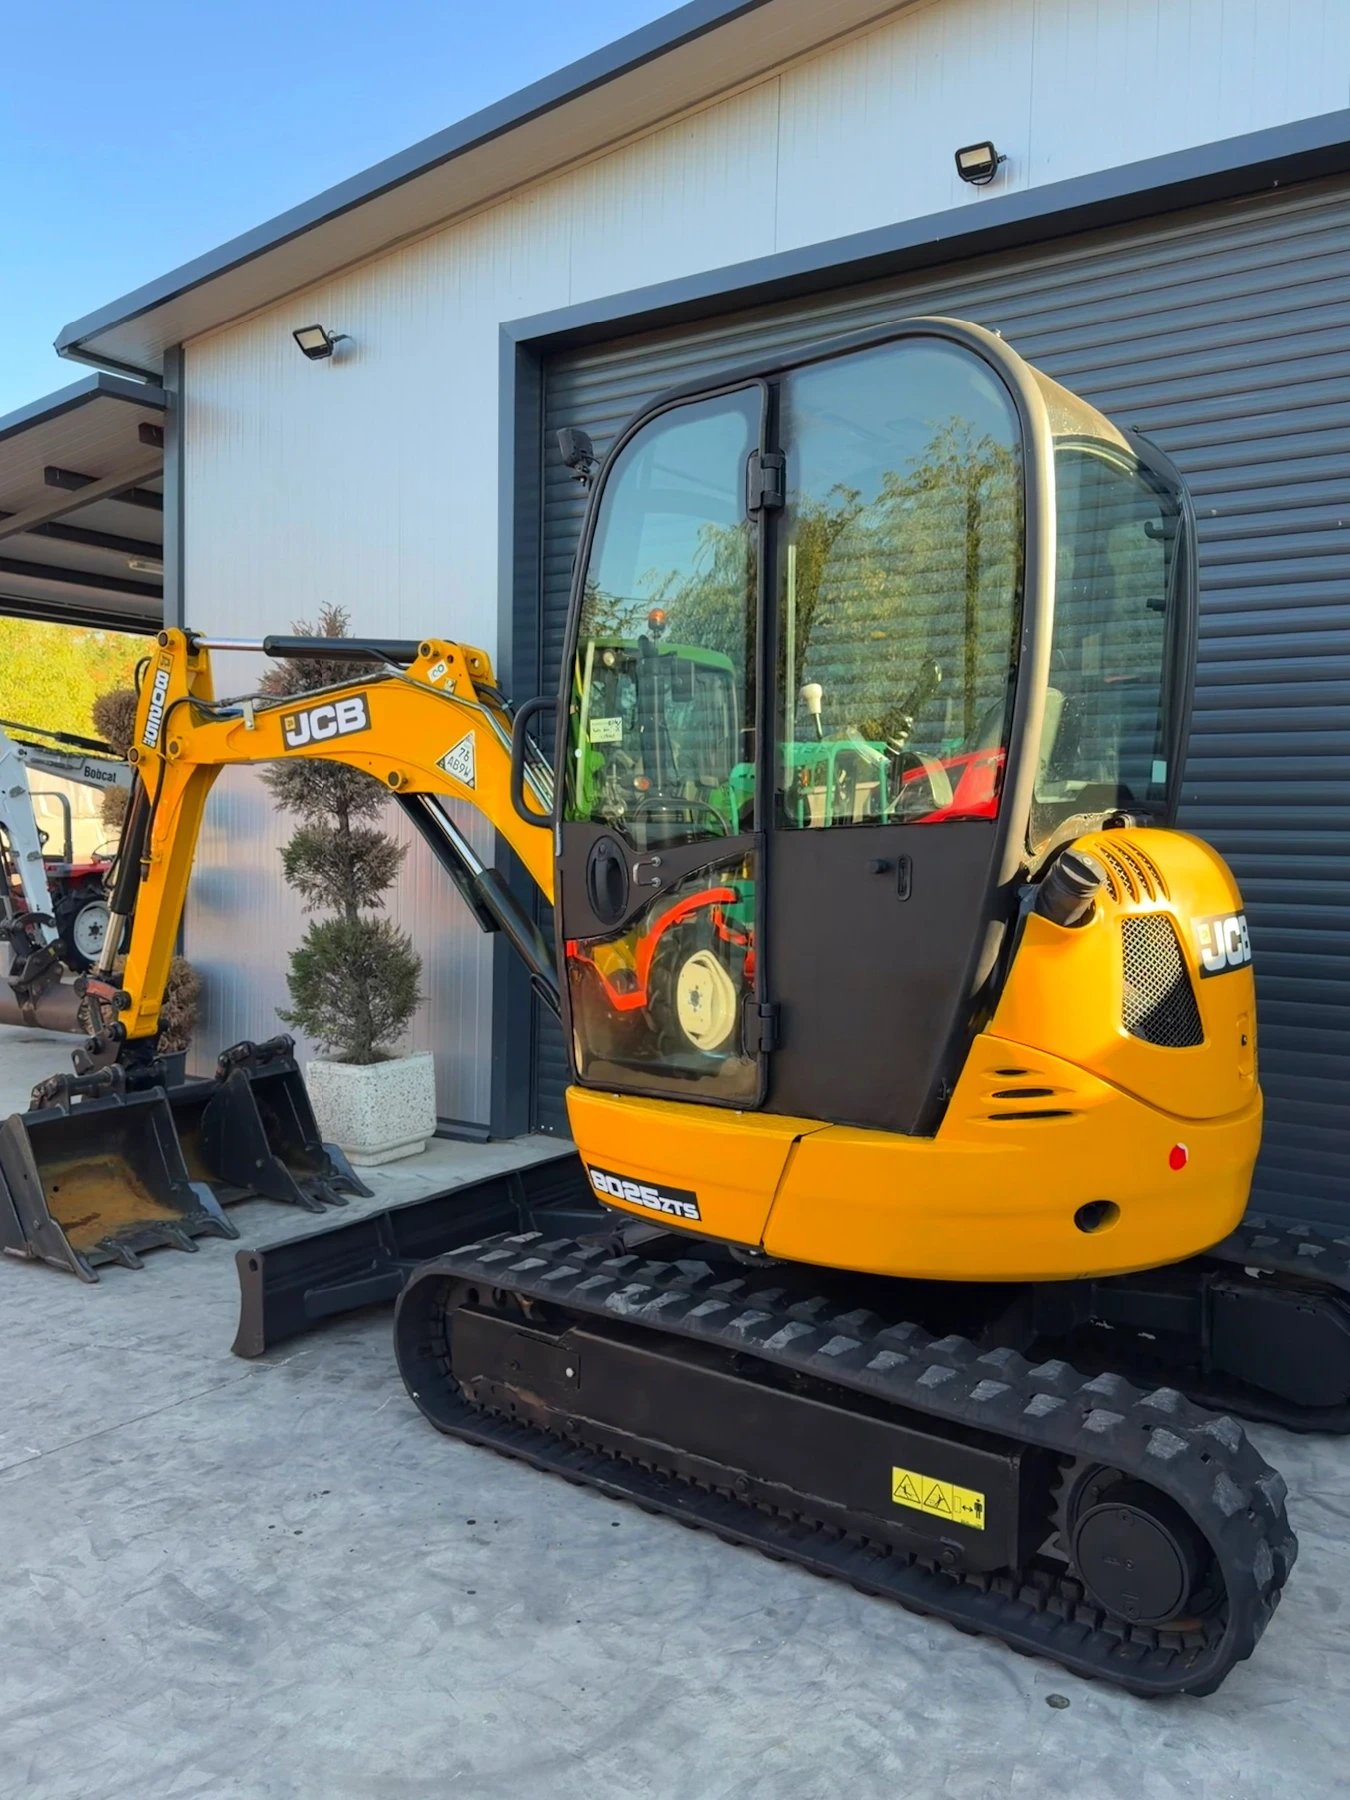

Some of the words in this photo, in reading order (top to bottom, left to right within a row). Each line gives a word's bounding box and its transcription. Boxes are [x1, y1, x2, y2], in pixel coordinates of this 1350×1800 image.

[286, 697, 366, 746] JCB
[84, 766, 117, 783] Bobcat
[1201, 915, 1252, 971] JCB
